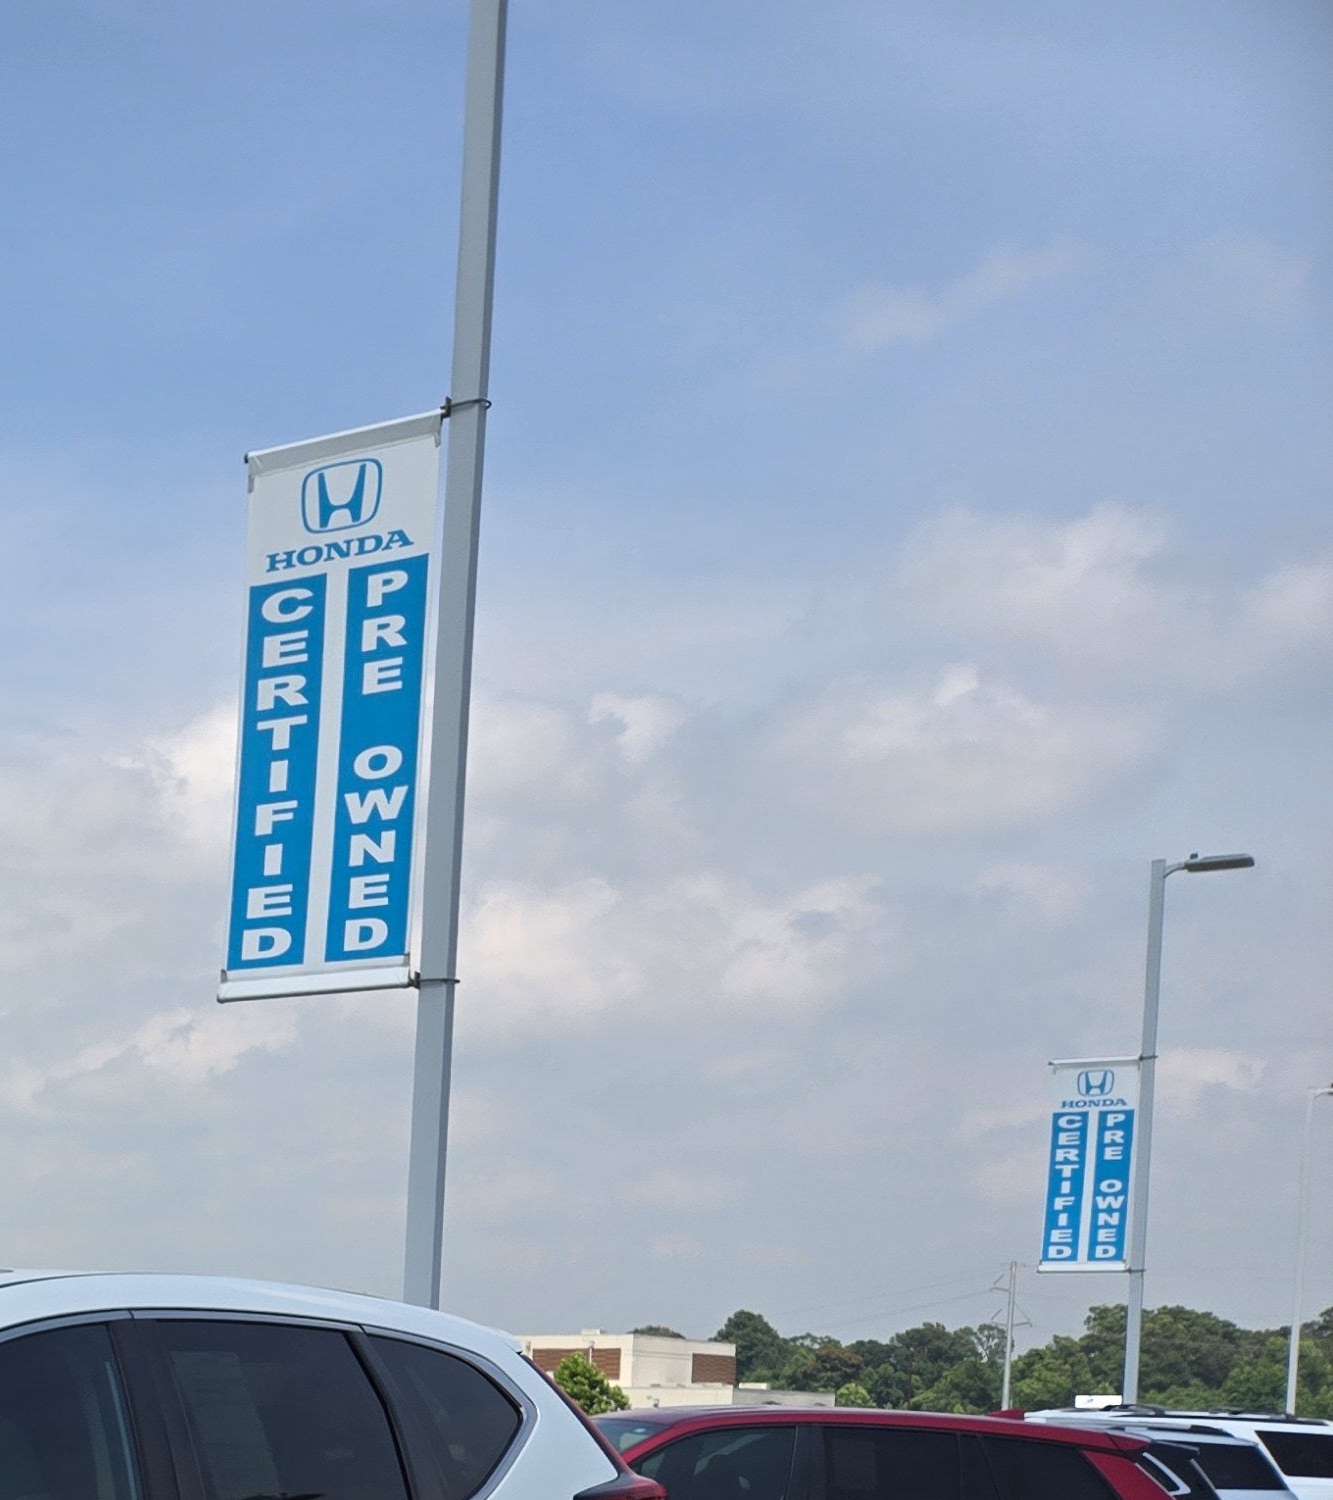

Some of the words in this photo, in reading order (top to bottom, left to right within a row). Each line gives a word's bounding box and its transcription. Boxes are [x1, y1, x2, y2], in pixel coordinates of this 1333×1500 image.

[266, 530, 414, 572] HONDA
[362, 571, 408, 695] PRE
[240, 588, 314, 961] CERTIFIED
[343, 745, 409, 952] OWNED
[1062, 1098, 1127, 1108] HONDA
[1105, 1113, 1125, 1160] PRE
[1048, 1115, 1083, 1259] CERTIFIED
[1095, 1179, 1124, 1258] OWNED
